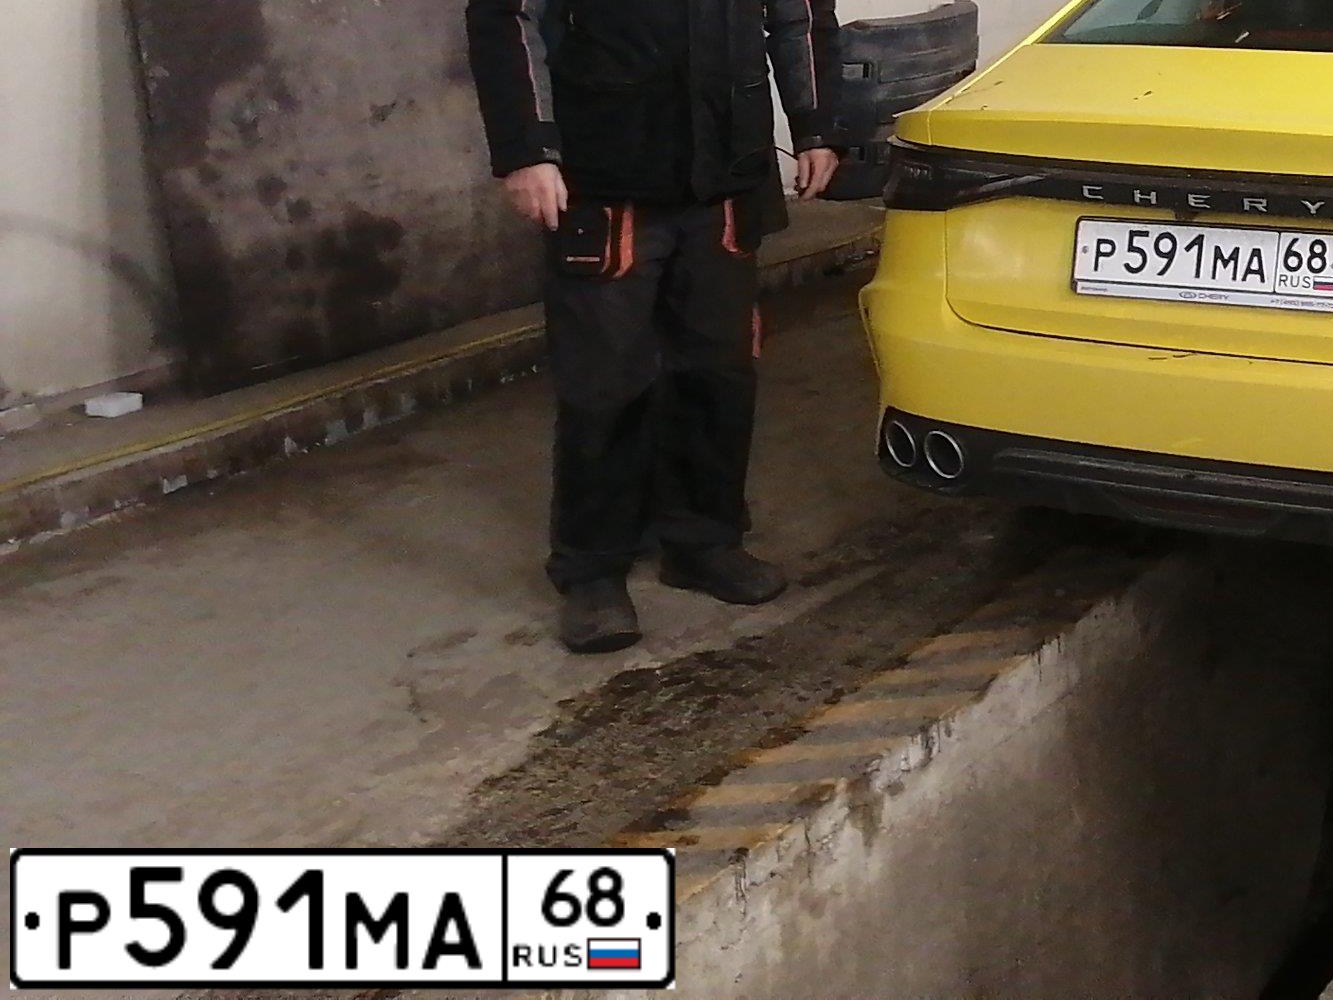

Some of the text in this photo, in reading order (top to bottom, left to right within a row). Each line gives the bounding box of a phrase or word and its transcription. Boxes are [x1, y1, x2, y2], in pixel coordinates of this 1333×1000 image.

[1082, 185, 1326, 215] CHERY
[1282, 237, 1328, 274] 68
[1279, 274, 1312, 289] RUS
